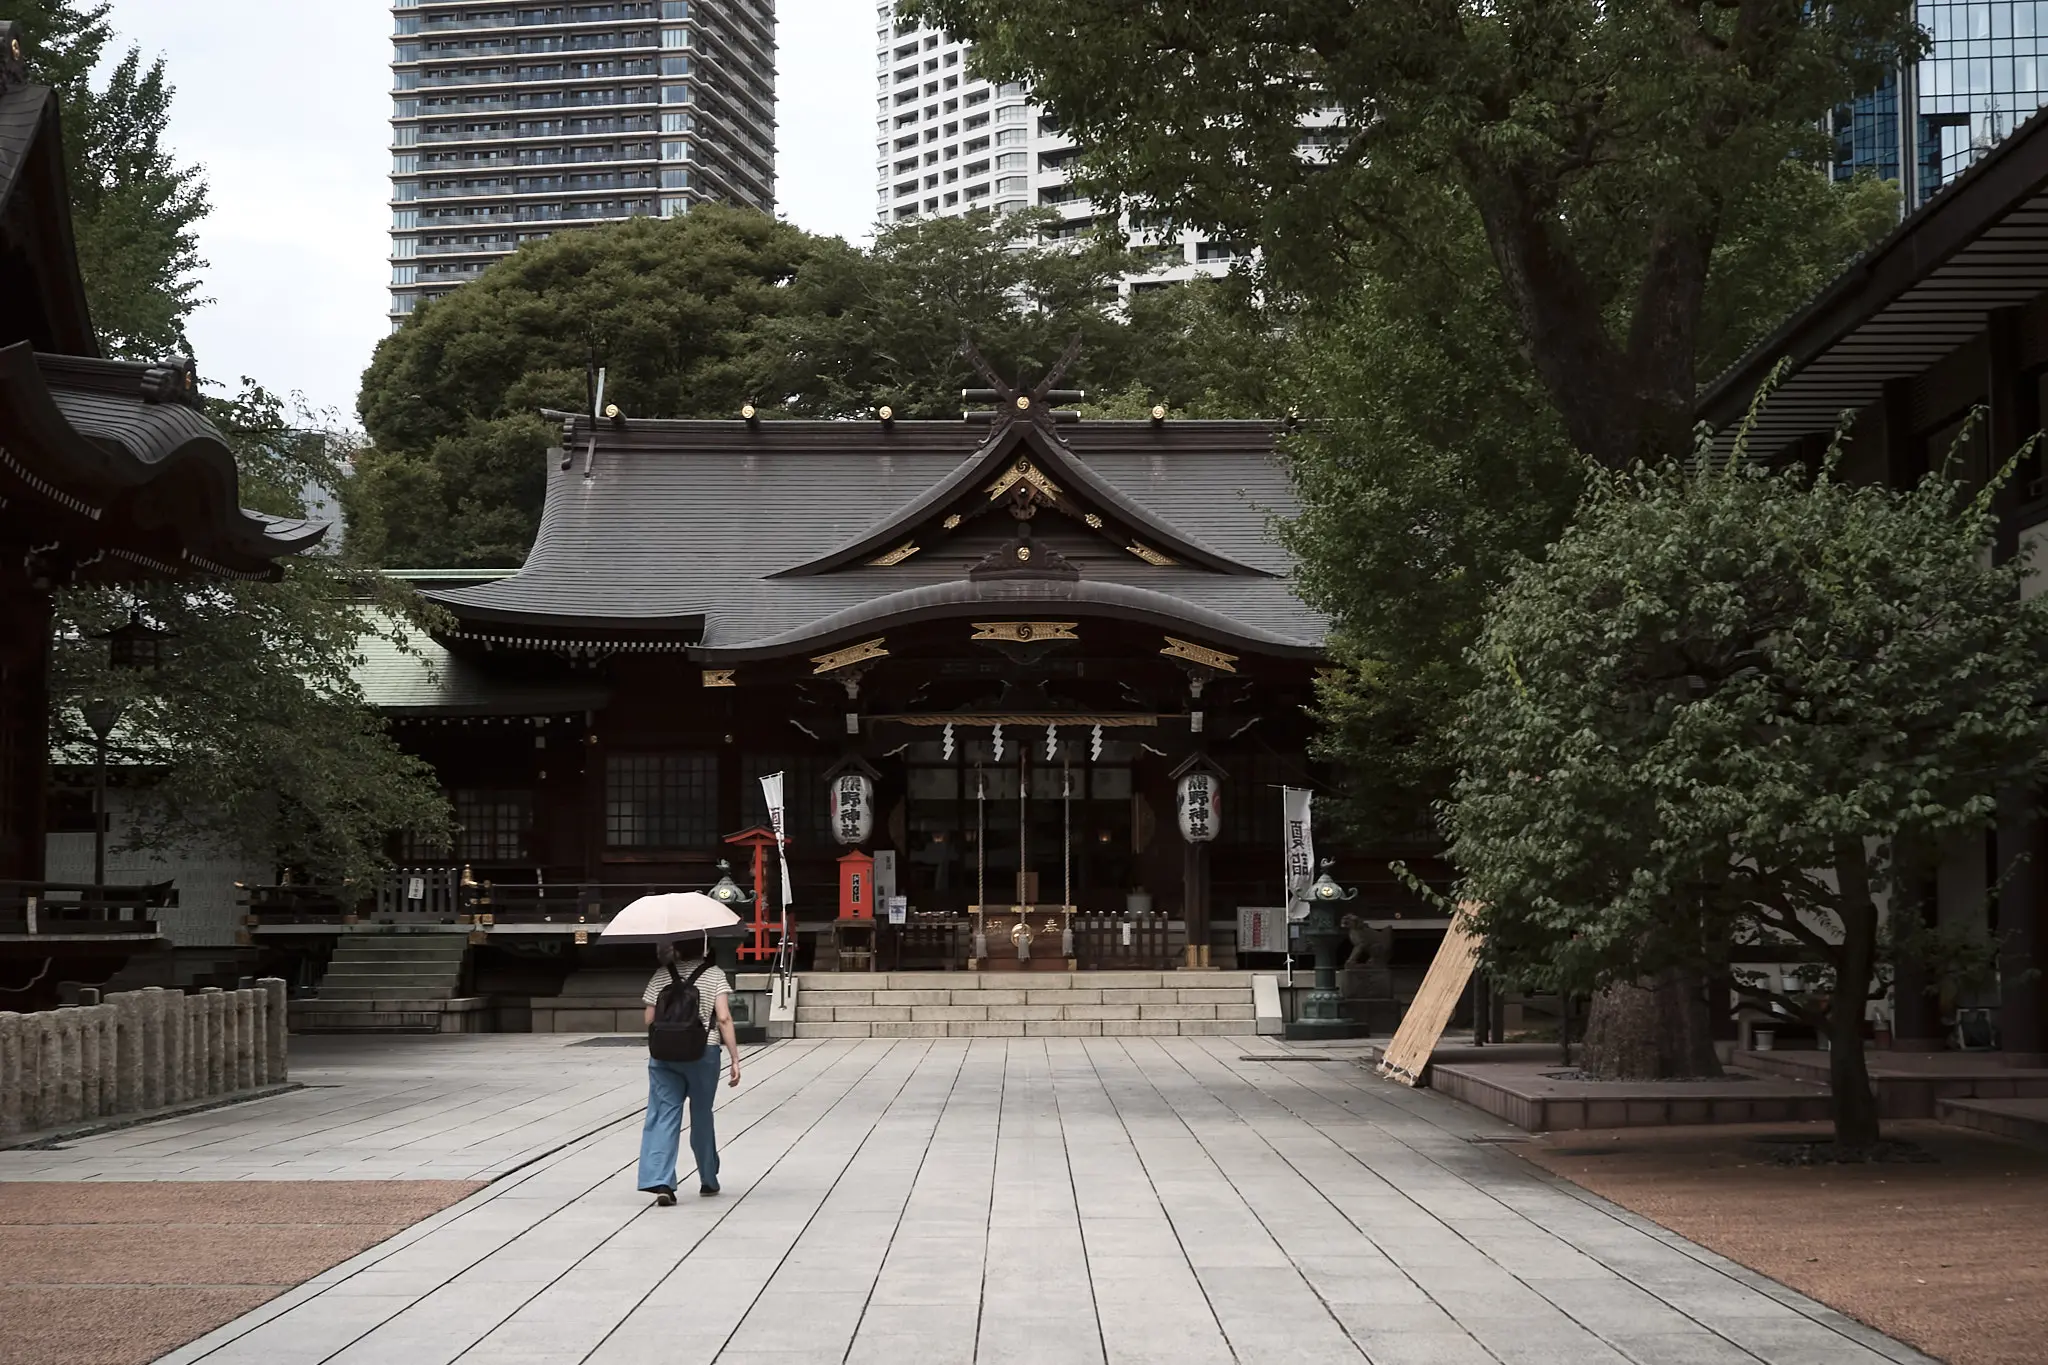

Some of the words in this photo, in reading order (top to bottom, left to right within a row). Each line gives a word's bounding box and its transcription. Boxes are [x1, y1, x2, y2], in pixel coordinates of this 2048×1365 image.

[840, 776, 861, 837] 熊野神社
[1188, 775, 1209, 836] 熊野神社
